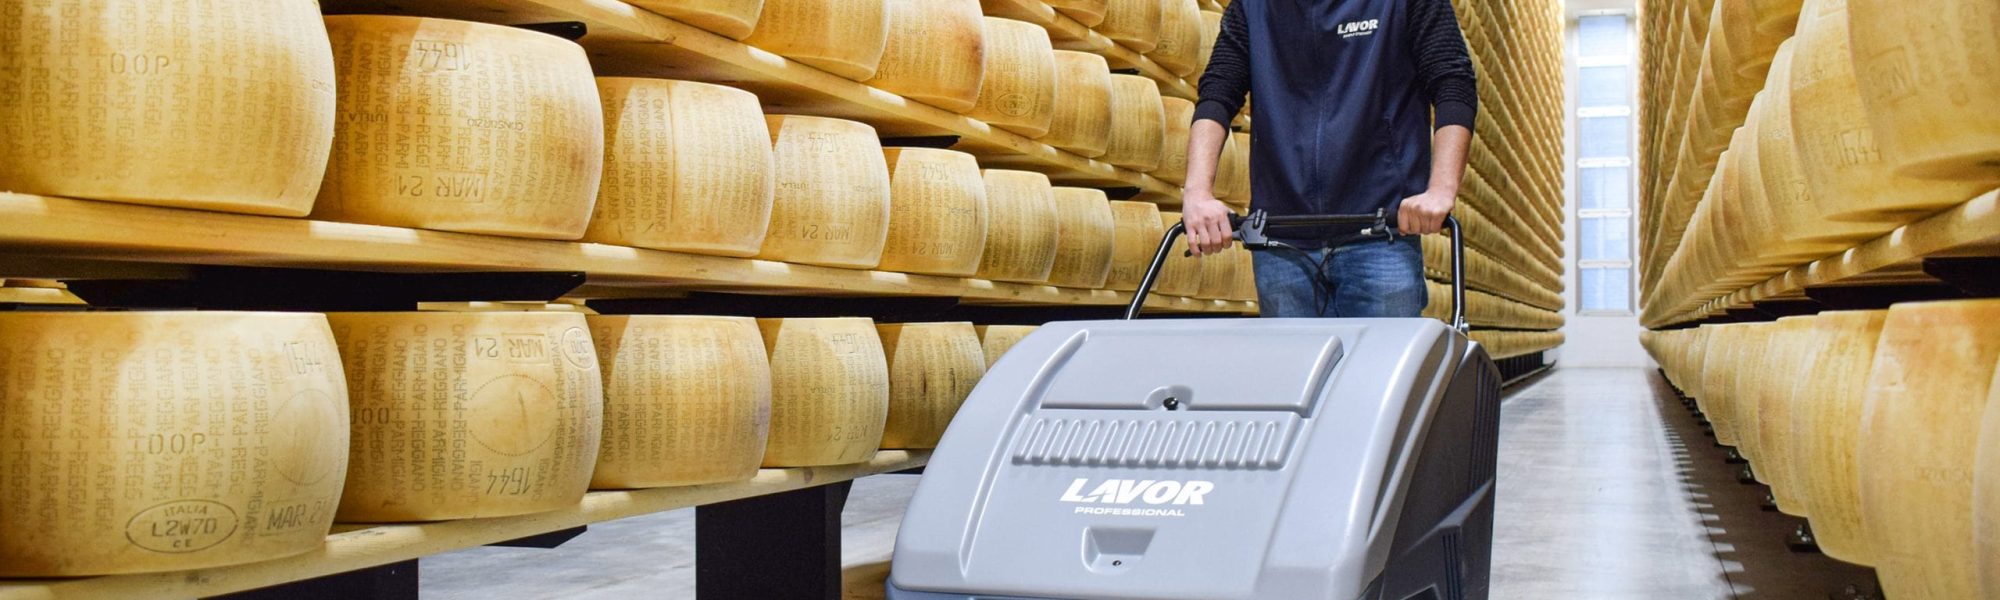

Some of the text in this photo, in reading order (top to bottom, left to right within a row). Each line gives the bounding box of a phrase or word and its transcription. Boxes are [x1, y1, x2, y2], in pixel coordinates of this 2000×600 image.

[1337, 18, 1379, 35] LAVOR
[110, 53, 170, 75] DOP
[415, 42, 471, 71] 1644
[398, 175, 481, 198] MAR 21
[475, 337, 498, 358] 21
[508, 337, 545, 359] MAR
[148, 432, 206, 455] DOP
[486, 466, 531, 496] 1644
[1059, 477, 1215, 505] LAVOR
[164, 505, 208, 517] ITALIA
[266, 503, 306, 530] MAR
[1074, 506, 1186, 517] PROFESSIONAL
